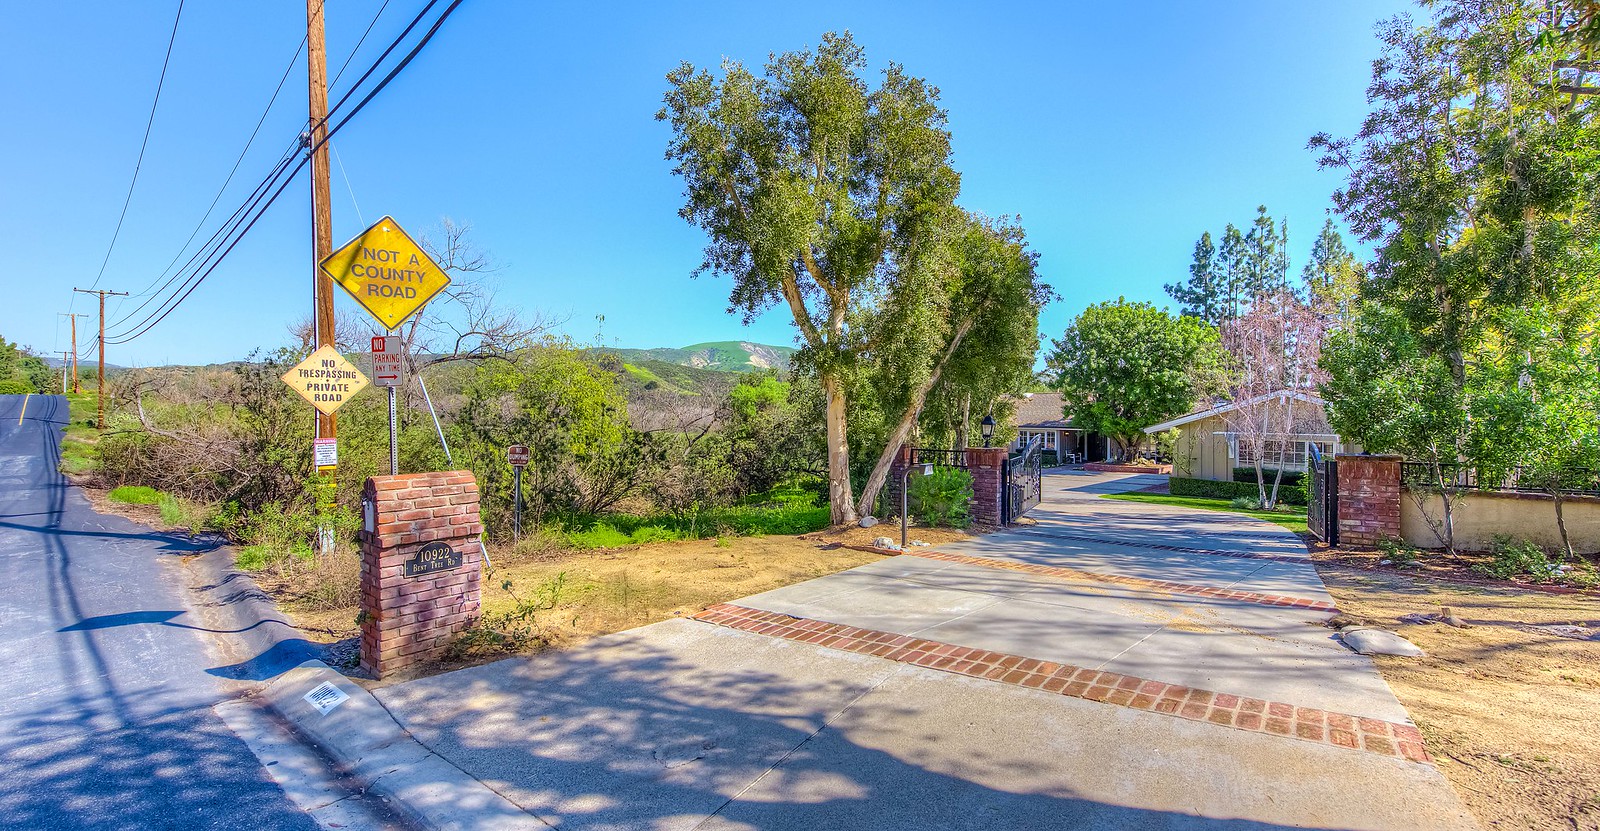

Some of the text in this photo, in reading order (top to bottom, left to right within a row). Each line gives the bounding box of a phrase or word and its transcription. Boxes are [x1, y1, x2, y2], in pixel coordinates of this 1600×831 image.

[364, 247, 420, 266] NOT A
[351, 264, 426, 284] COUNTY
[368, 284, 416, 298] ROAD
[374, 338, 383, 350] NO
[322, 360, 336, 368] NO
[374, 354, 400, 363] PARKING
[298, 368, 356, 378] TRESPASSING
[306, 383, 349, 392] PRIVATE
[314, 394, 342, 402] ROAD
[420, 548, 450, 562] 10922
[413, 564, 427, 572] BENT
[448, 558, 456, 566] RD
